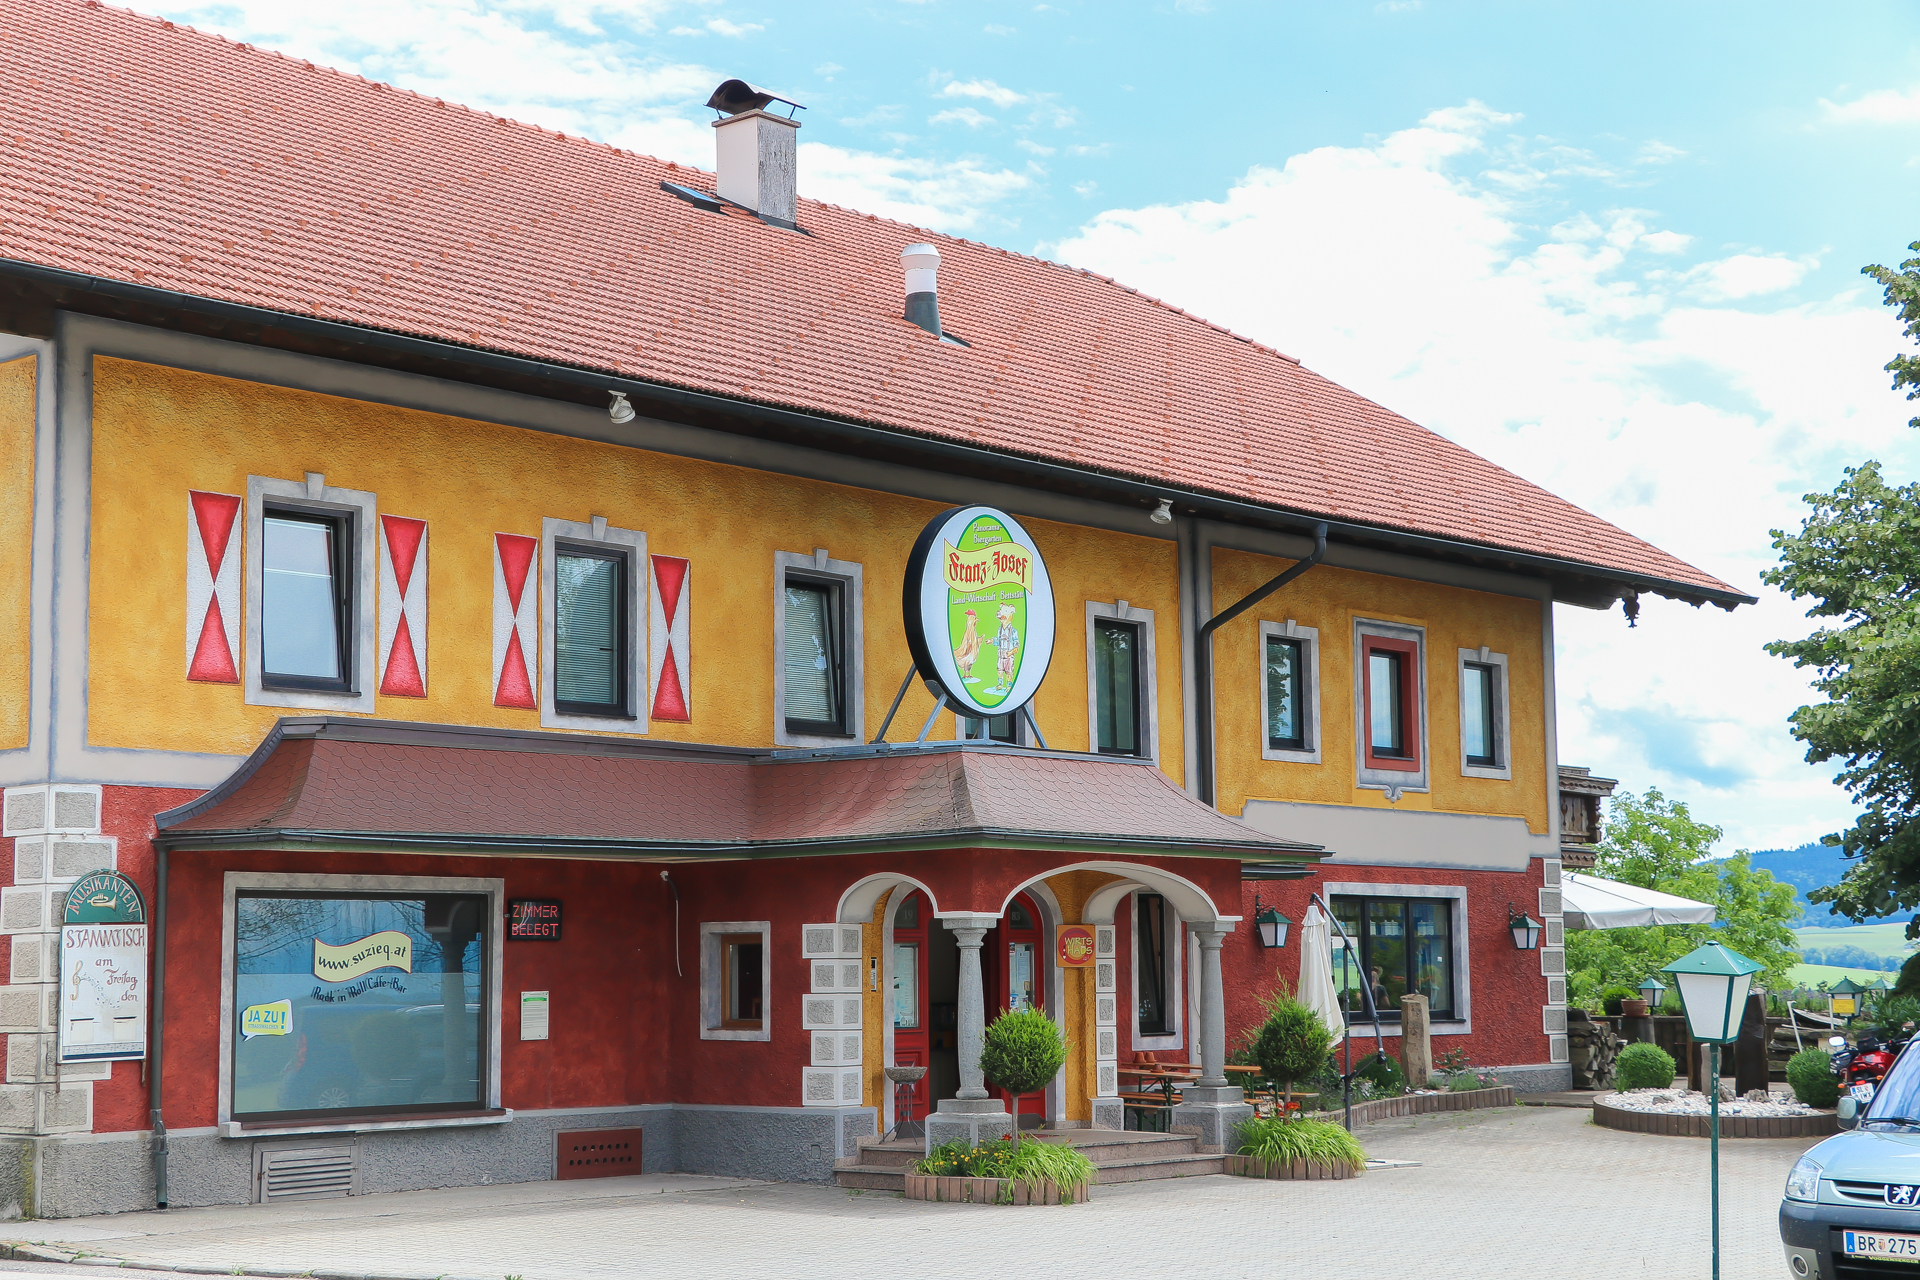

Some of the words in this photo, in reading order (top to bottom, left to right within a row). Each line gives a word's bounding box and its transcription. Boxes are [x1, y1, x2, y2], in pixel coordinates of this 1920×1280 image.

[973, 523, 1002, 532] Panorama-
[973, 534, 1002, 546] Biergarten
[949, 551, 1028, 584] Franz-Josef
[68, 877, 139, 915] MUSIKANTEN
[512, 905, 558, 918] ZIMMER
[511, 923, 559, 937] BELEGT
[66, 928, 145, 948] STAMMTISCH
[1064, 937, 1093, 946] WIRTS
[95, 958, 113, 967] am
[318, 943, 406, 970] www.suzieq.at
[103, 967, 138, 991] Freitag
[121, 990, 138, 1002] den
[312, 986, 335, 1003] Rock
[348, 980, 367, 998] Roll
[248, 1010, 261, 1023] JA
[1858, 1235, 1876, 1252] BR
